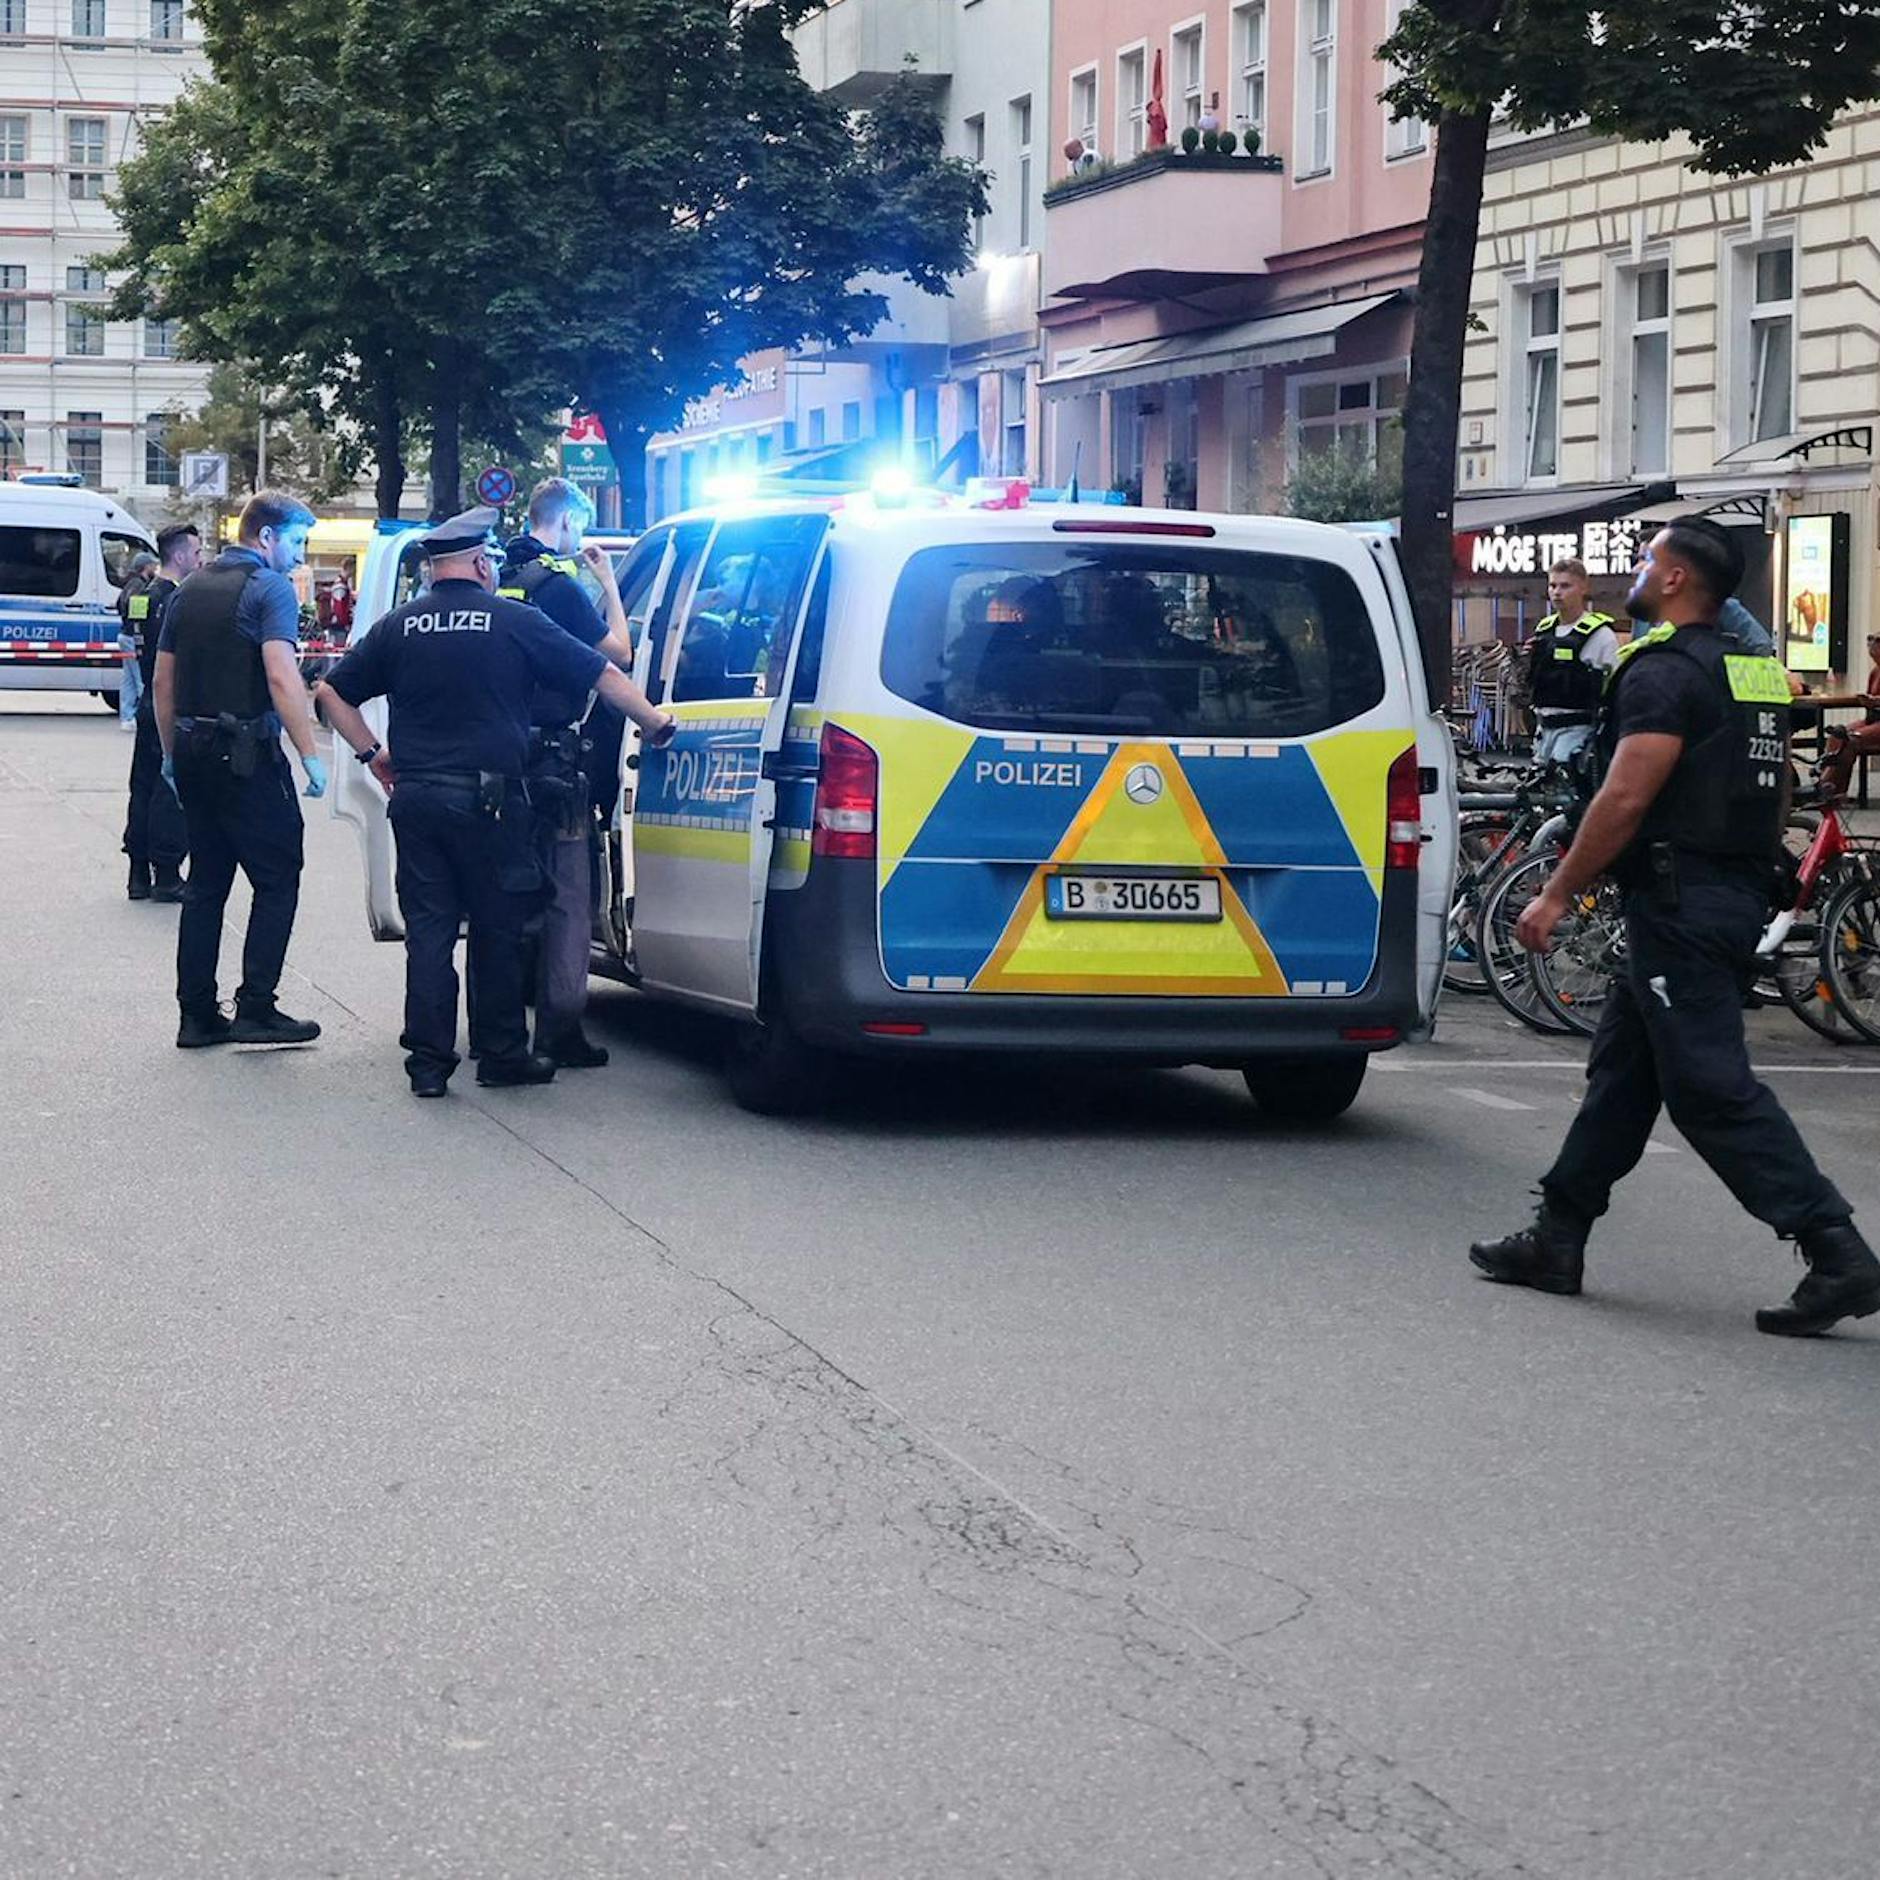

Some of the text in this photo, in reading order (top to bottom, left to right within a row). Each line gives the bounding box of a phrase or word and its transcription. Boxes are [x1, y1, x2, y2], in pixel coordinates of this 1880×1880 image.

[2, 626, 58, 639] POLIZEI
[403, 610, 492, 637] POLIZEI
[1758, 711, 1777, 736] BE
[661, 750, 744, 803] POLIZEI
[975, 761, 1081, 787] POLIZEI
[1067, 881, 1084, 908] B
[1112, 883, 1200, 911] 30665
